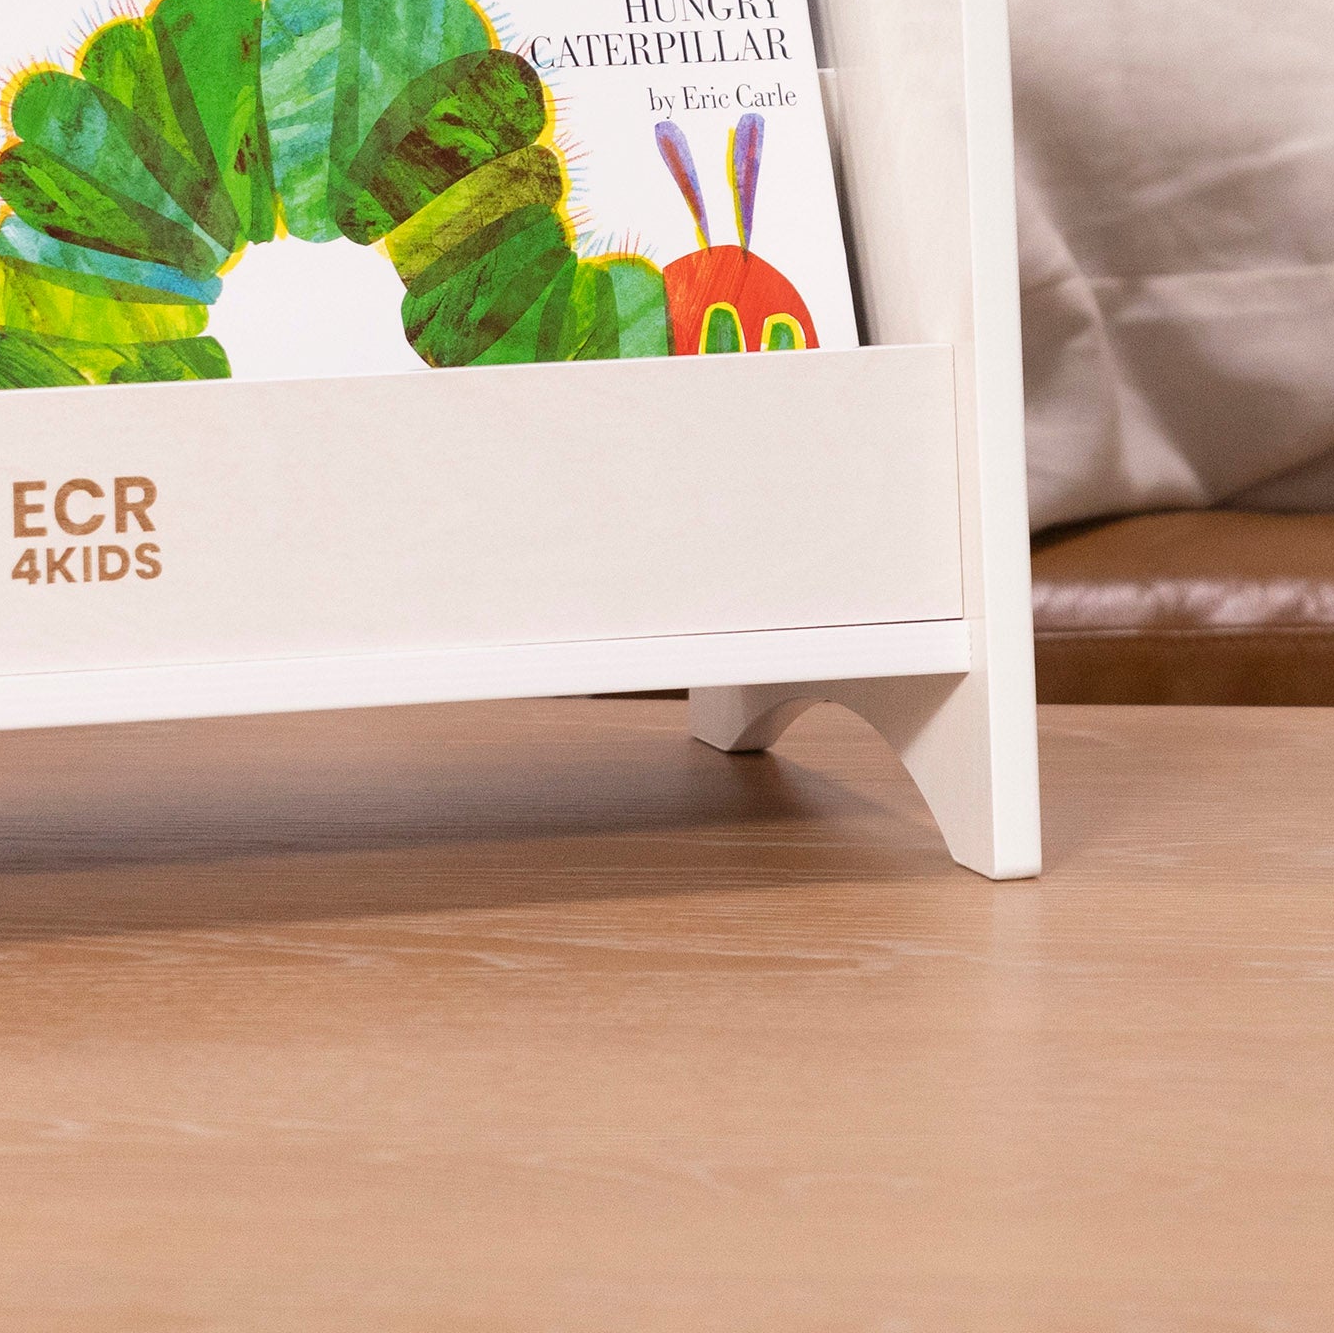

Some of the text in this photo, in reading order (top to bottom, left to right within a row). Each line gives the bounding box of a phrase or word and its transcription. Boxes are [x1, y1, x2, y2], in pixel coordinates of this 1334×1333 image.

[530, 26, 793, 70] CATERPILLAR
[647, 82, 798, 119] by Eric Carle
[12, 475, 158, 539] ECR
[10, 541, 163, 586] 4KIDS
